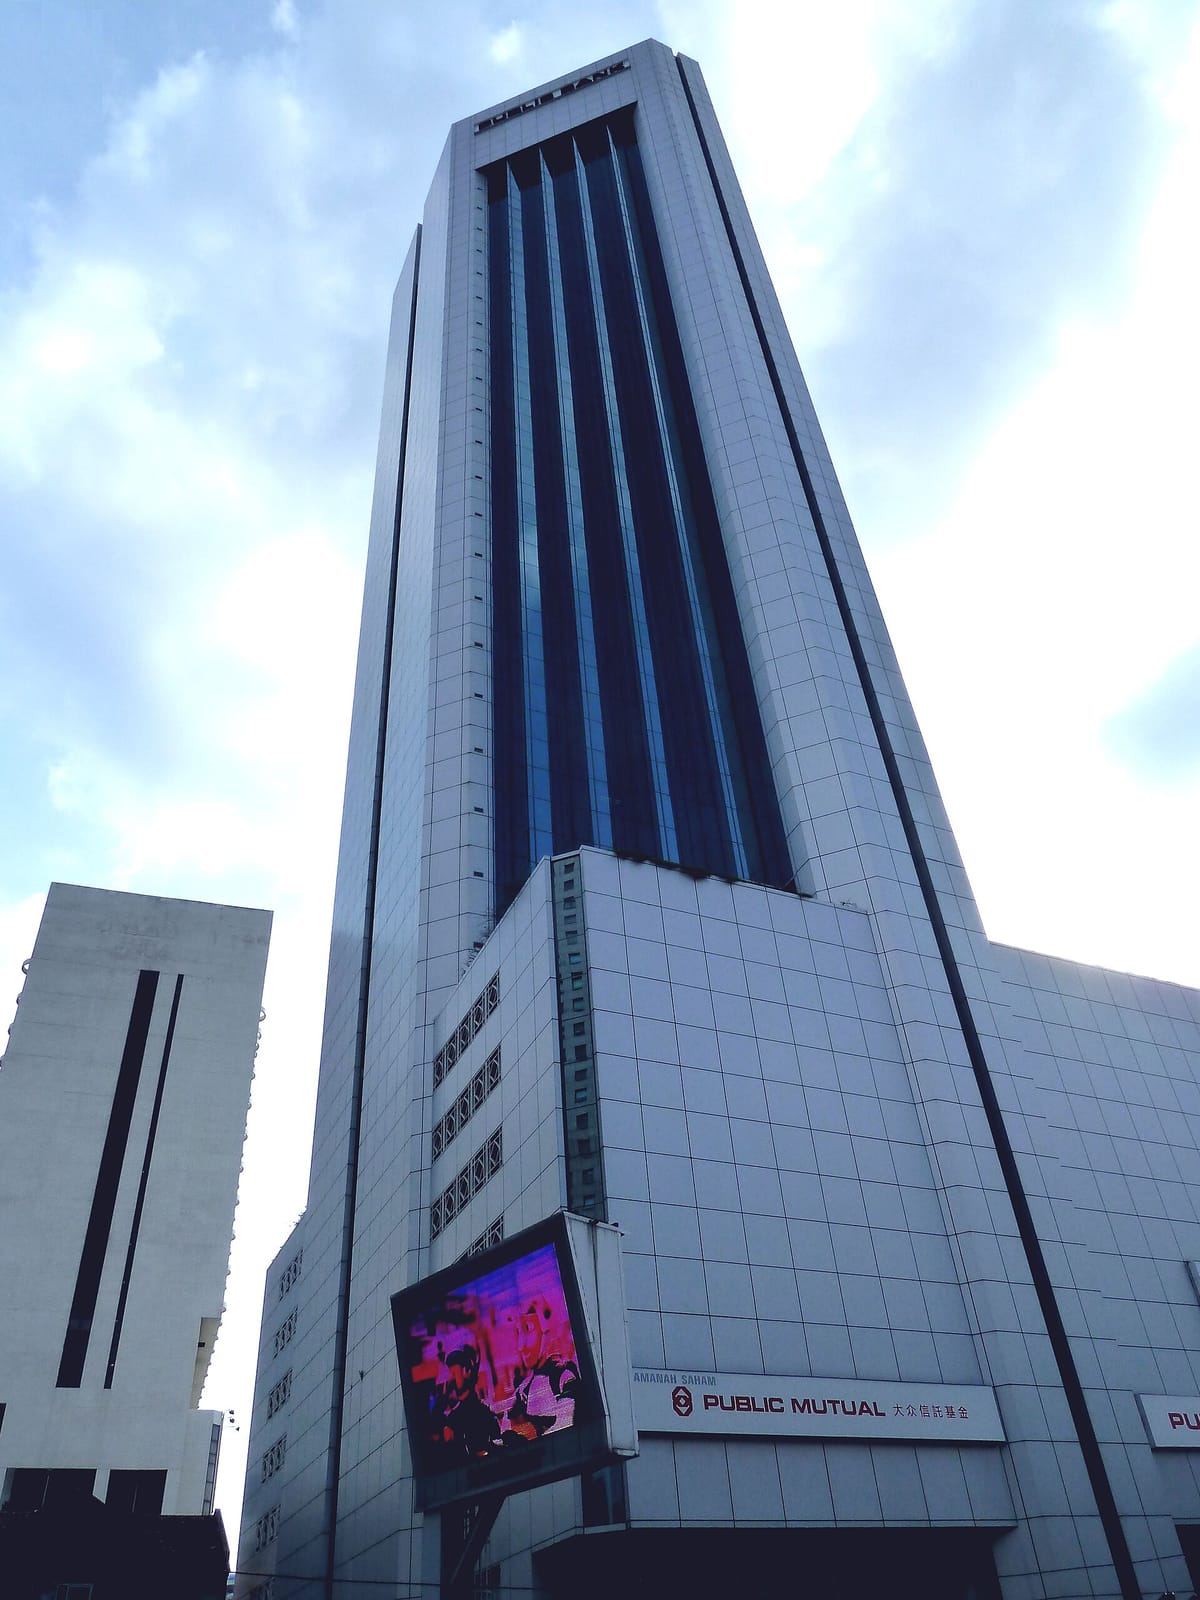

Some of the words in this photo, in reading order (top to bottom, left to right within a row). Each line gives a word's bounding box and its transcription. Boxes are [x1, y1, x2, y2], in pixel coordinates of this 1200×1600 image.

[634, 1371, 677, 1385] AMANAH
[682, 1375, 716, 1387] SAHAM
[703, 1394, 784, 1413] PUBLIC
[791, 1398, 886, 1416] MUTUAL
